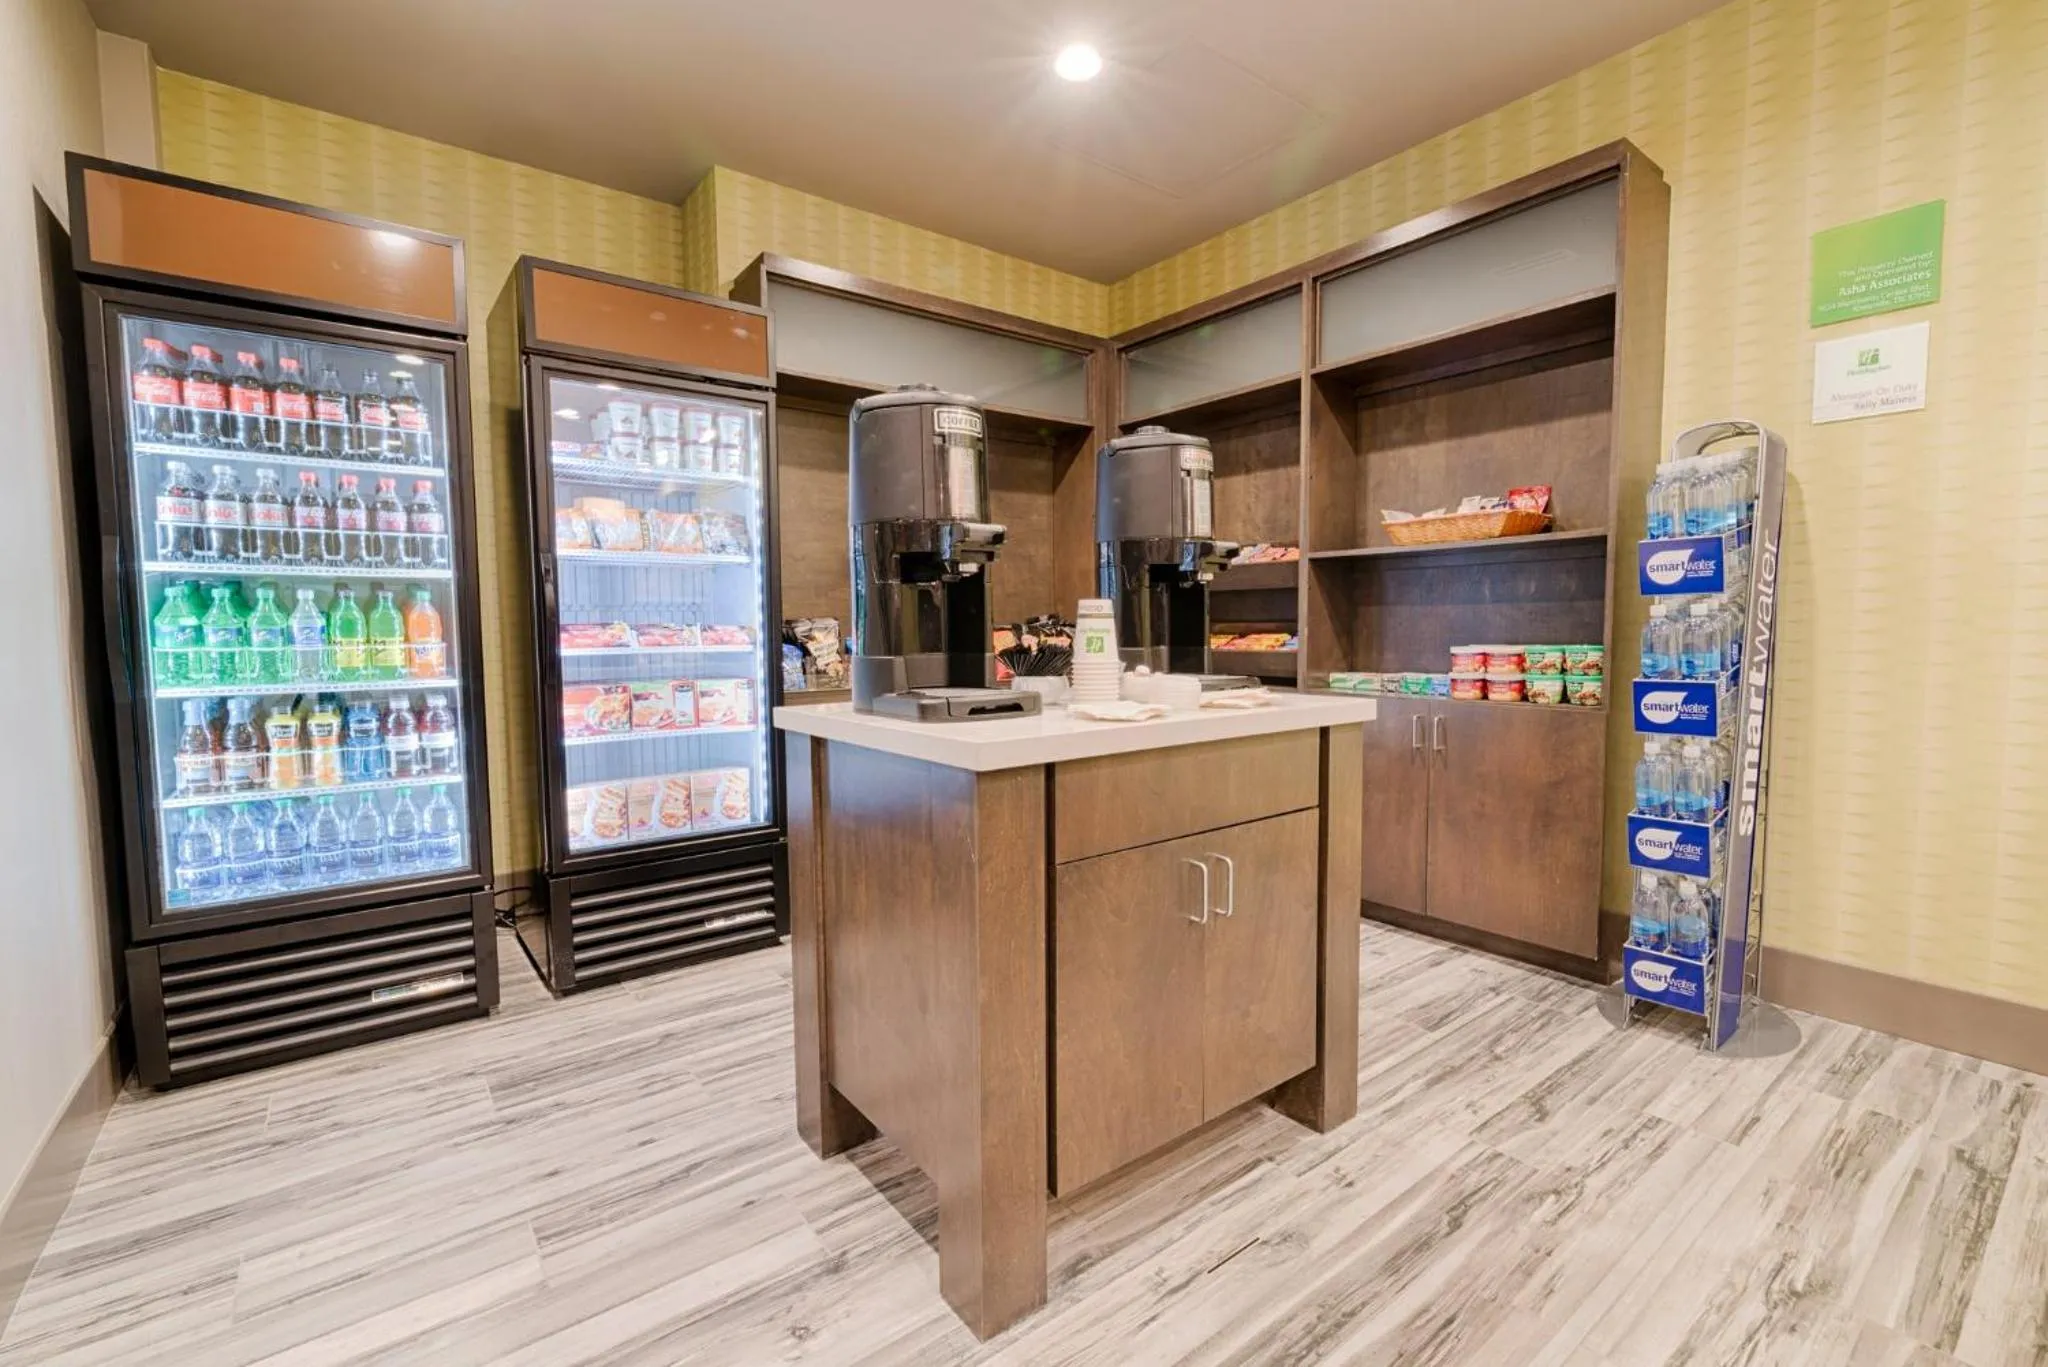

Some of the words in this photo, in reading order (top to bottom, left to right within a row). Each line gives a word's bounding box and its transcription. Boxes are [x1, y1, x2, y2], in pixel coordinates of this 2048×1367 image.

[1838, 283, 1867, 297] Asha
[1868, 270, 1932, 291] Associates
[1649, 558, 1716, 573] smartwater
[1737, 528, 1778, 837] smartwater
[1643, 701, 1710, 715] smartwater
[1638, 838, 1704, 856] smartwater
[1633, 967, 1698, 990] smartwater
